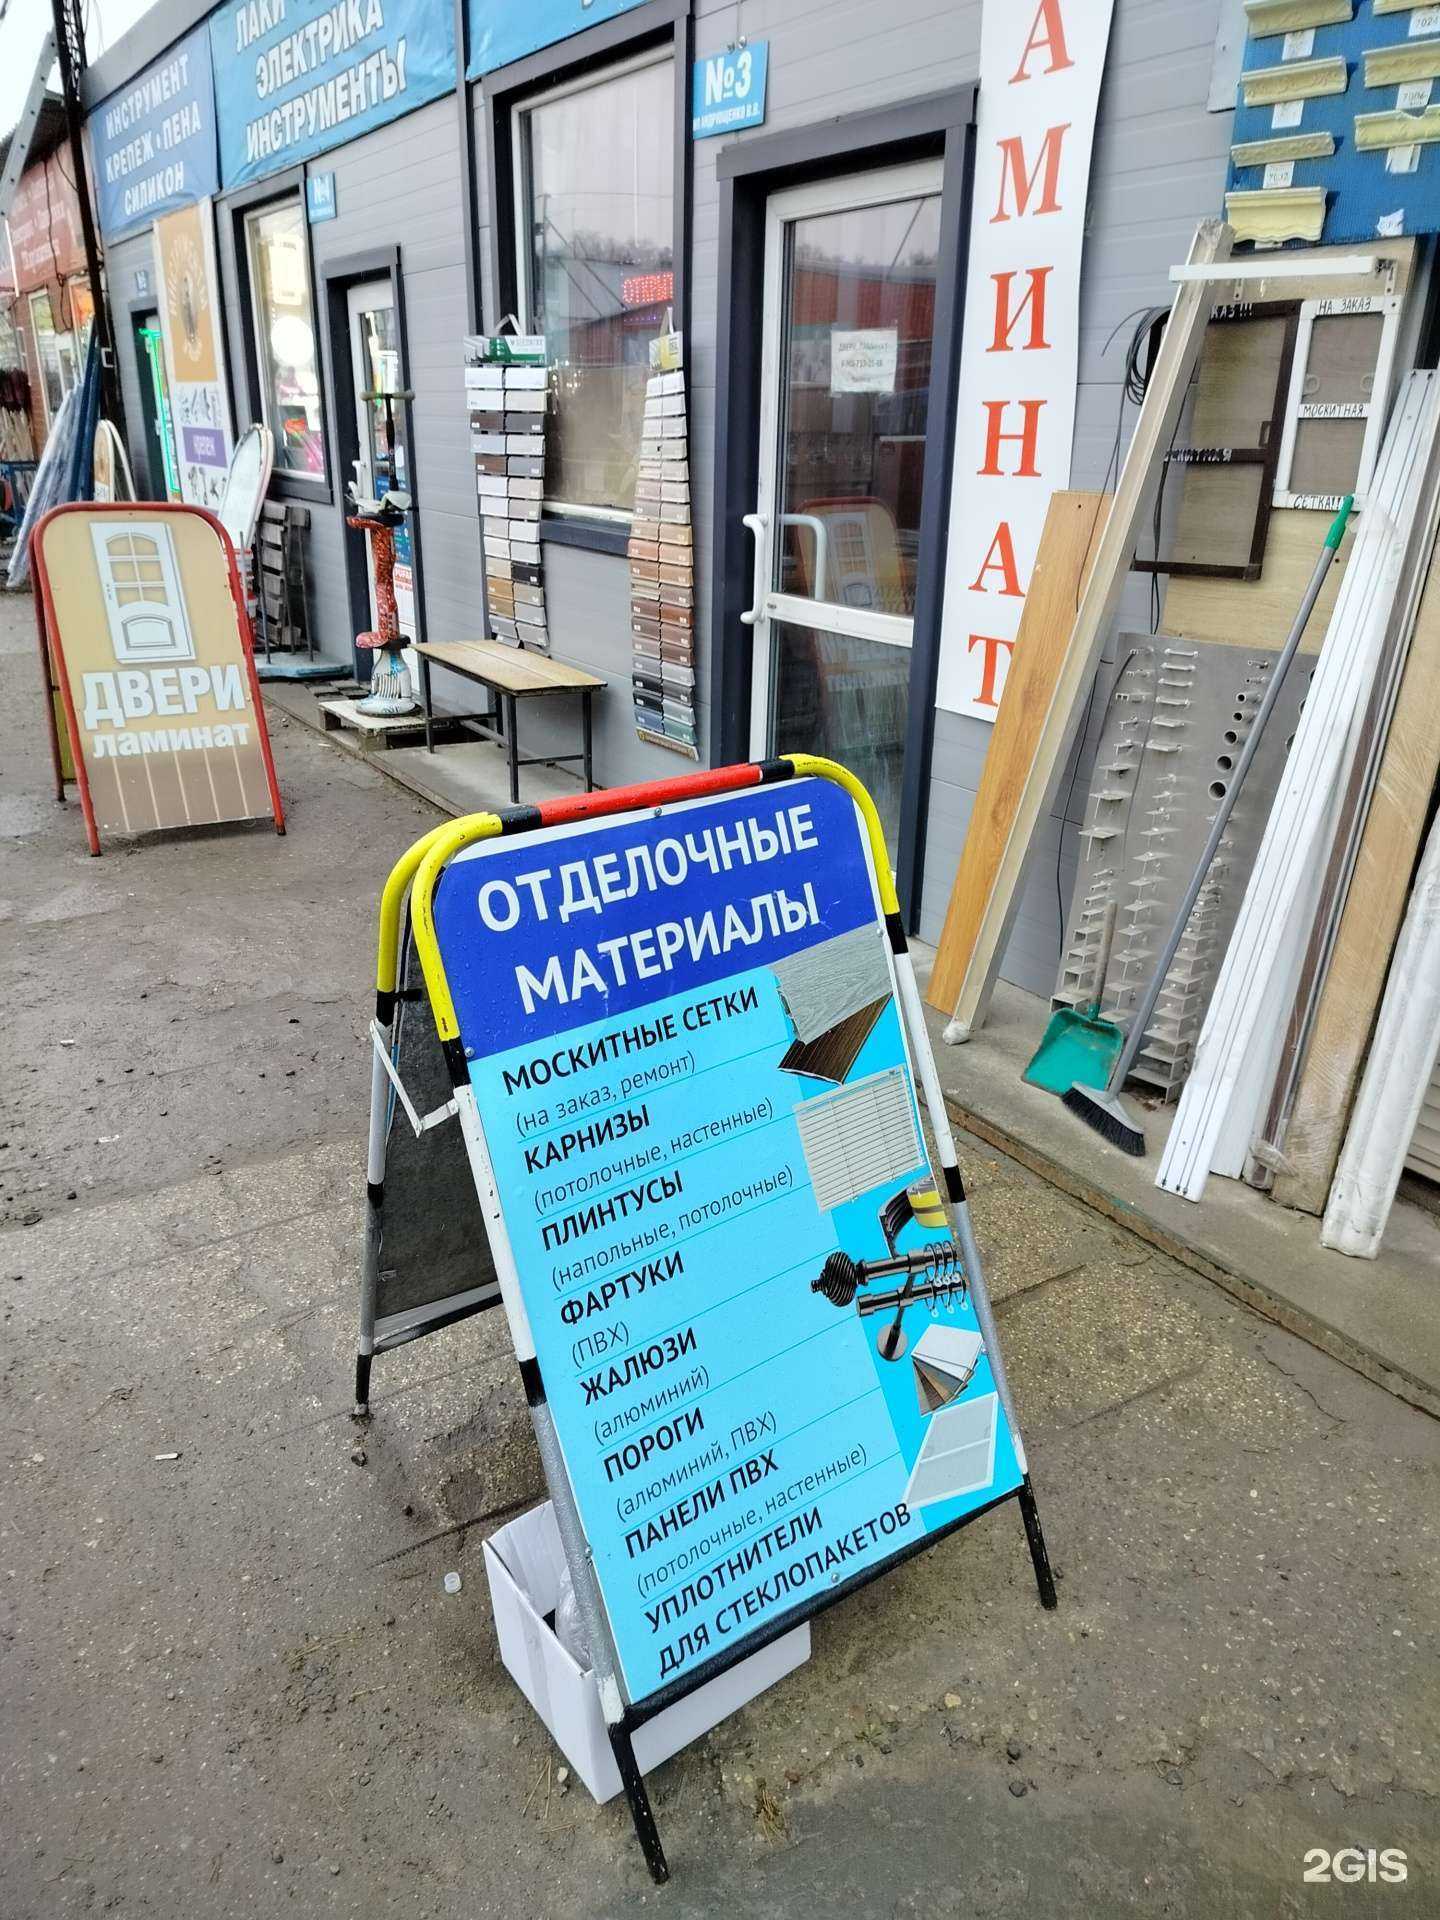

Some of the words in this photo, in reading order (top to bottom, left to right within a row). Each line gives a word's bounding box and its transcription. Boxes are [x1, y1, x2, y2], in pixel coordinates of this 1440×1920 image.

[236, 0, 286, 53] ЛАКИ
[256, 0, 384, 99] ЭЛЕКТРИКА
[105, 53, 189, 140] ИНСТРУМЕНТ
[246, 36, 407, 163] ИНСТРУМЕНТЫ
[705, 50, 752, 106] №3
[104, 130, 155, 183] КРЕПЕЖ
[162, 101, 202, 151] ПЕНА
[124, 160, 185, 216] СИЛИКОН
[1209, 302, 1254, 319] КАЗ!!!
[1318, 299, 1334, 314] НА
[1340, 297, 1372, 312] ЗАКАЗ
[1303, 405, 1365, 417] МОСКИТНАЯ
[82, 663, 246, 731] ДВЕРИ
[92, 722, 250, 759] ламинат
[478, 803, 819, 932] ОТДЕЛОЧНЫЕ
[515, 881, 821, 1015] МАТЕРИАЛЫ
[502, 1014, 678, 1095] МОСКИТНЫЕ
[682, 986, 759, 1032] СЕТКИ
[516, 1109, 549, 1138] (на
[557, 1086, 618, 1120] заказ,
[621, 1050, 697, 1099] ремонт)
[525, 1103, 651, 1175] КАРНИЗЫ
[534, 1145, 668, 1216] (потолочные,
[670, 1097, 775, 1154] настенные)
[541, 1170, 684, 1251] ПЛИНТУСЫ
[551, 1221, 676, 1292] (напольные,
[678, 1164, 794, 1231] потолочные)
[560, 1250, 685, 1326] ФАРТУКИ
[571, 1320, 630, 1369] (ПВХ)
[579, 1327, 698, 1406] ЖАЛЮЗИ
[594, 1364, 710, 1446] (алюминий)
[603, 1406, 705, 1483] ПОРОГИ
[616, 1440, 730, 1523] (алюминий,
[730, 1410, 777, 1452] ПВХ)
[625, 1481, 727, 1559] ПАНЕЛИ
[729, 1449, 780, 1495] ПВХ
[637, 1507, 763, 1599] (потолочные,
[765, 1442, 868, 1515] настенные)
[644, 1507, 824, 1635] УПЛОТНИТЕЛИ
[659, 1622, 711, 1680] ДЛЯ
[715, 1502, 912, 1636] СТЕКЛОПАКЕТОВ
